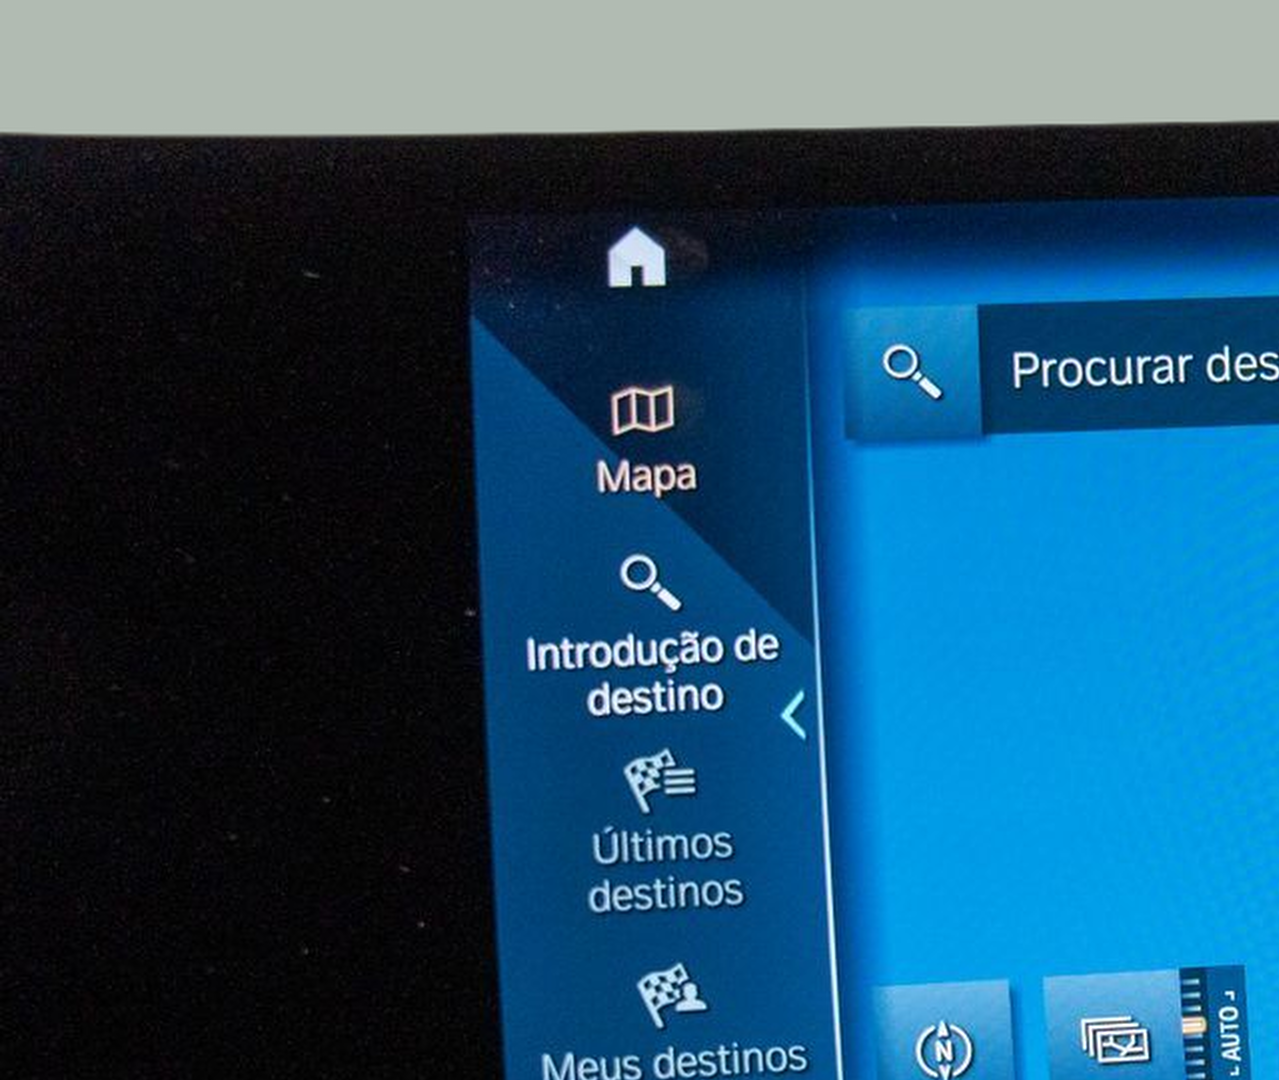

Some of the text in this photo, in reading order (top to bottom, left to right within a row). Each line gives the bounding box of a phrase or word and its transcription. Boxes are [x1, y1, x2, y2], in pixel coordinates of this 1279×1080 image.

[1012, 351, 1194, 389] Procurar
[597, 460, 697, 497] Mapa
[526, 628, 779, 672] Introdução de
[587, 681, 724, 715] destino
[592, 826, 734, 865] Últimos
[588, 877, 745, 913] destinos
[934, 1039, 954, 1063] N
[1218, 1005, 1241, 1062] AUTO
[653, 1041, 809, 1080] destinos
